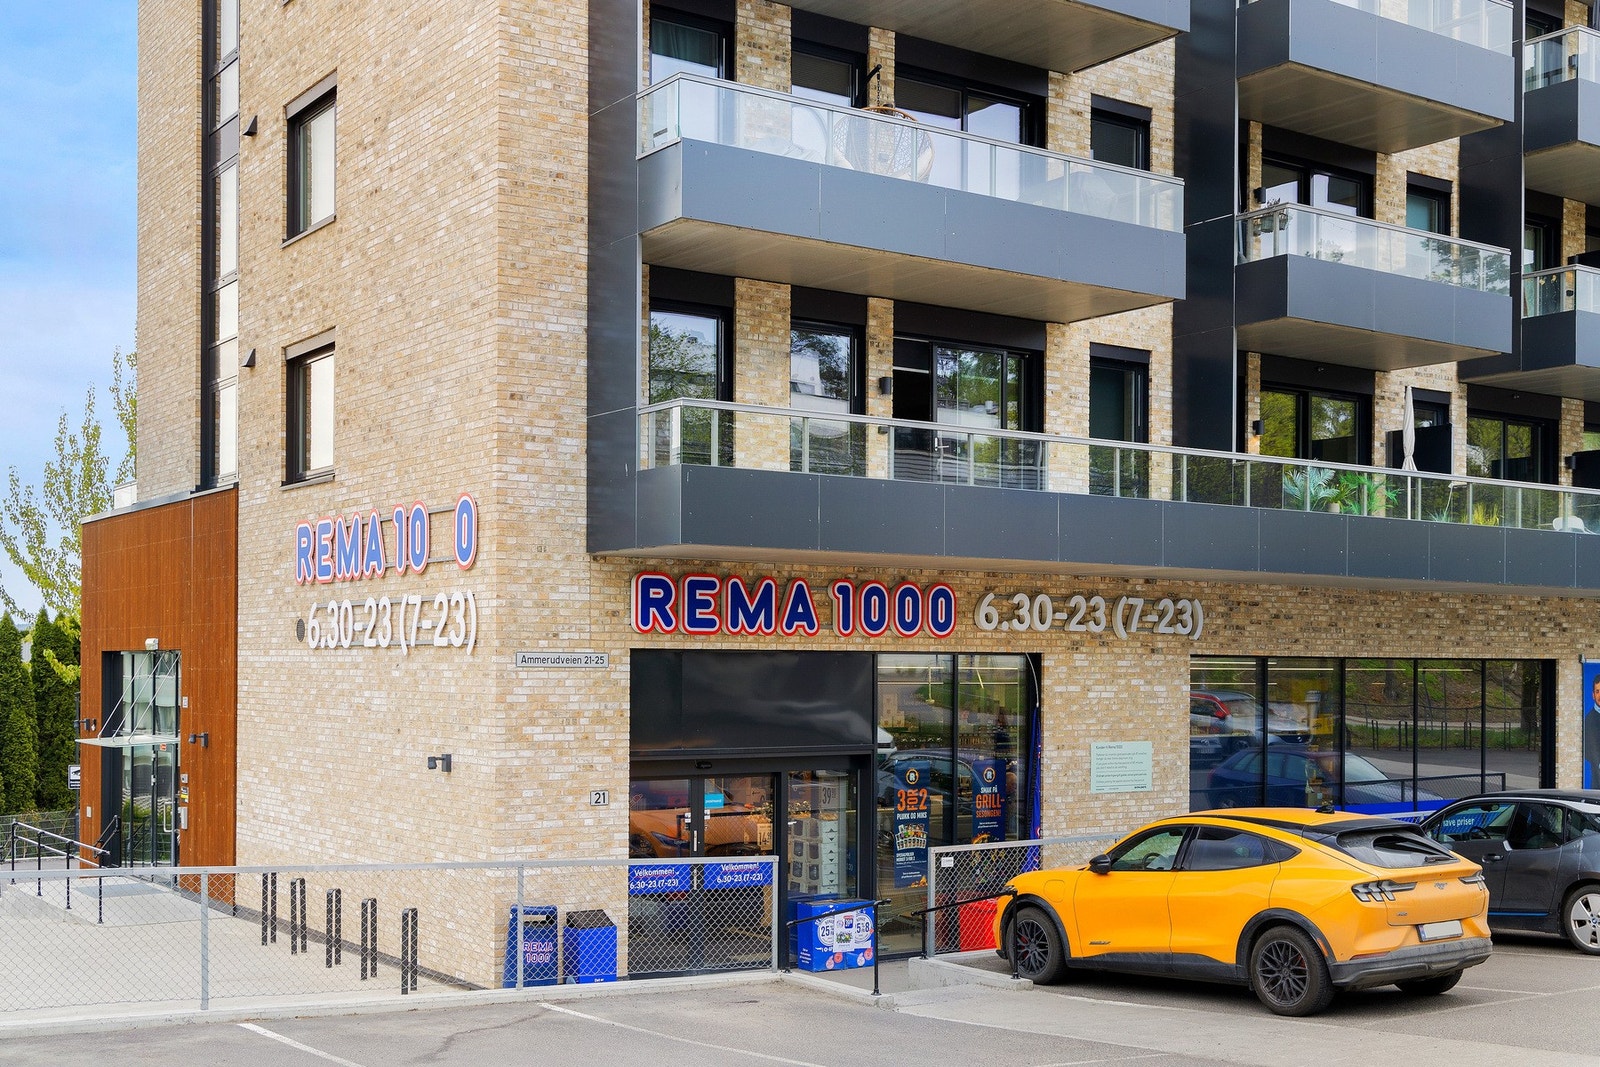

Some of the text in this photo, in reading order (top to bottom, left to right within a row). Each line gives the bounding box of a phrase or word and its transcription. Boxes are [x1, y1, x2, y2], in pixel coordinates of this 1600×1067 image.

[295, 508, 385, 586] REMA
[630, 572, 958, 640] REMA 1000
[307, 589, 477, 656] 6.30-23 (7-23)
[973, 592, 1204, 641] 6.30-23 (7-23)
[520, 654, 605, 665] Ammerudveien 21-25
[594, 792, 606, 804] 21
[897, 788, 928, 812] 3 FOR 2
[975, 794, 1005, 809] GRILL-
[1456, 816, 1475, 827] priser
[821, 925, 830, 937] 25
[523, 942, 553, 952] REMA
[526, 953, 551, 963] 1000
